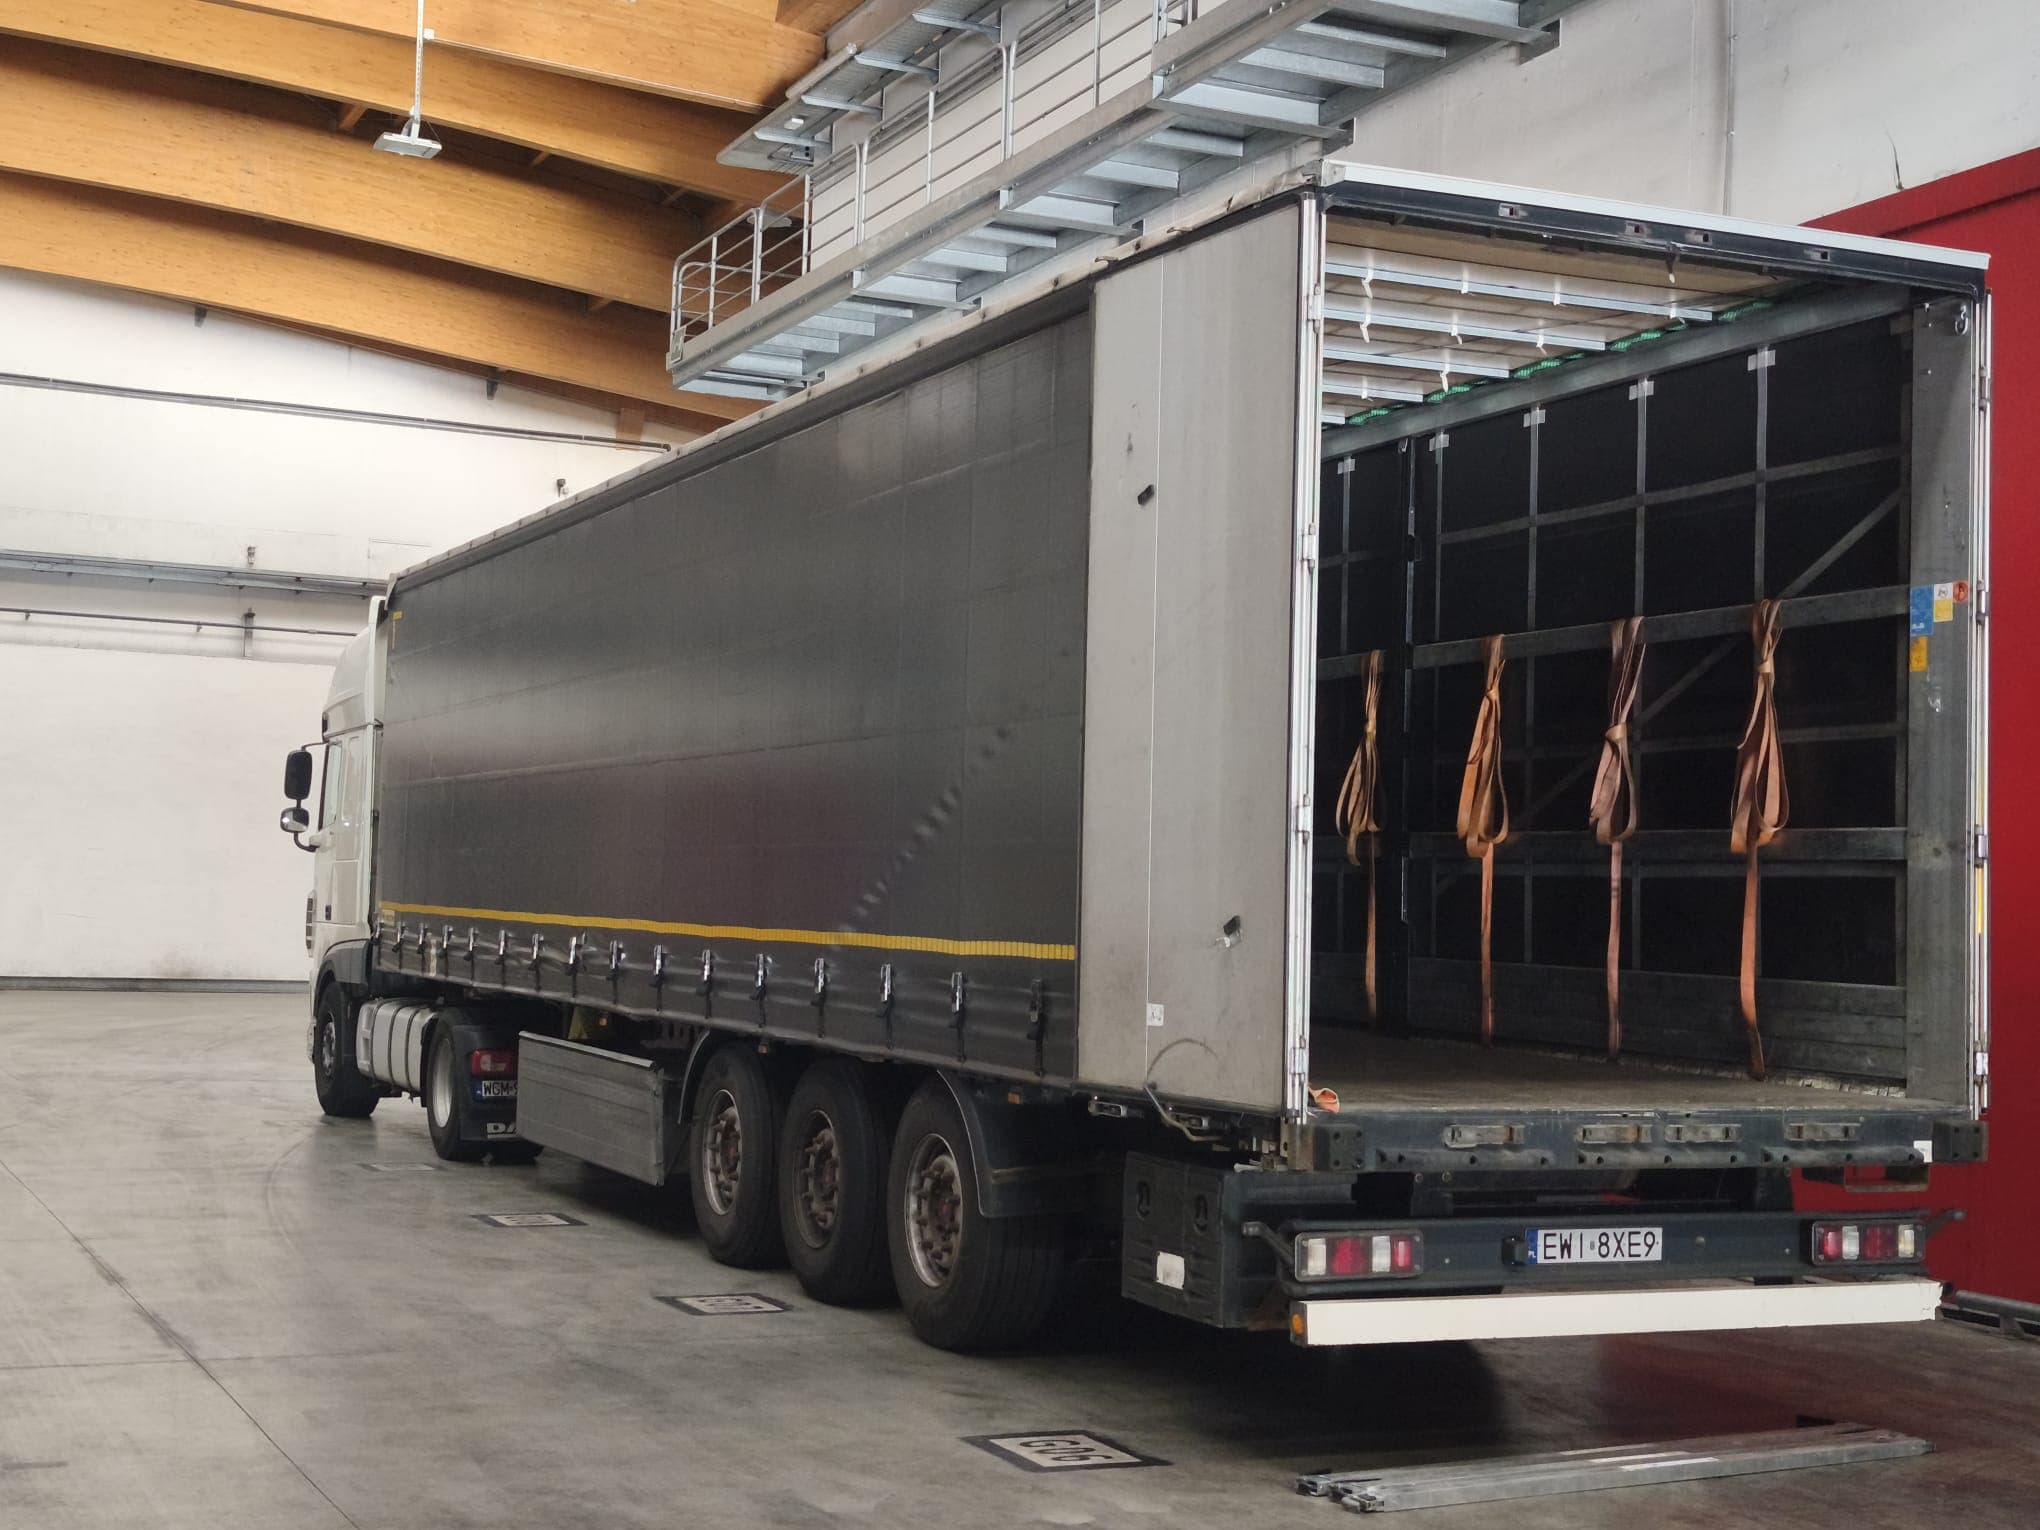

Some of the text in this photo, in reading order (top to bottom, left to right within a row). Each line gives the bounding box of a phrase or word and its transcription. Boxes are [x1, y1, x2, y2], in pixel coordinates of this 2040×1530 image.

[484, 1082, 510, 1096] WGM
[1543, 1231, 1656, 1260] EWI 8XE9
[1019, 1439, 1113, 1462] G06
